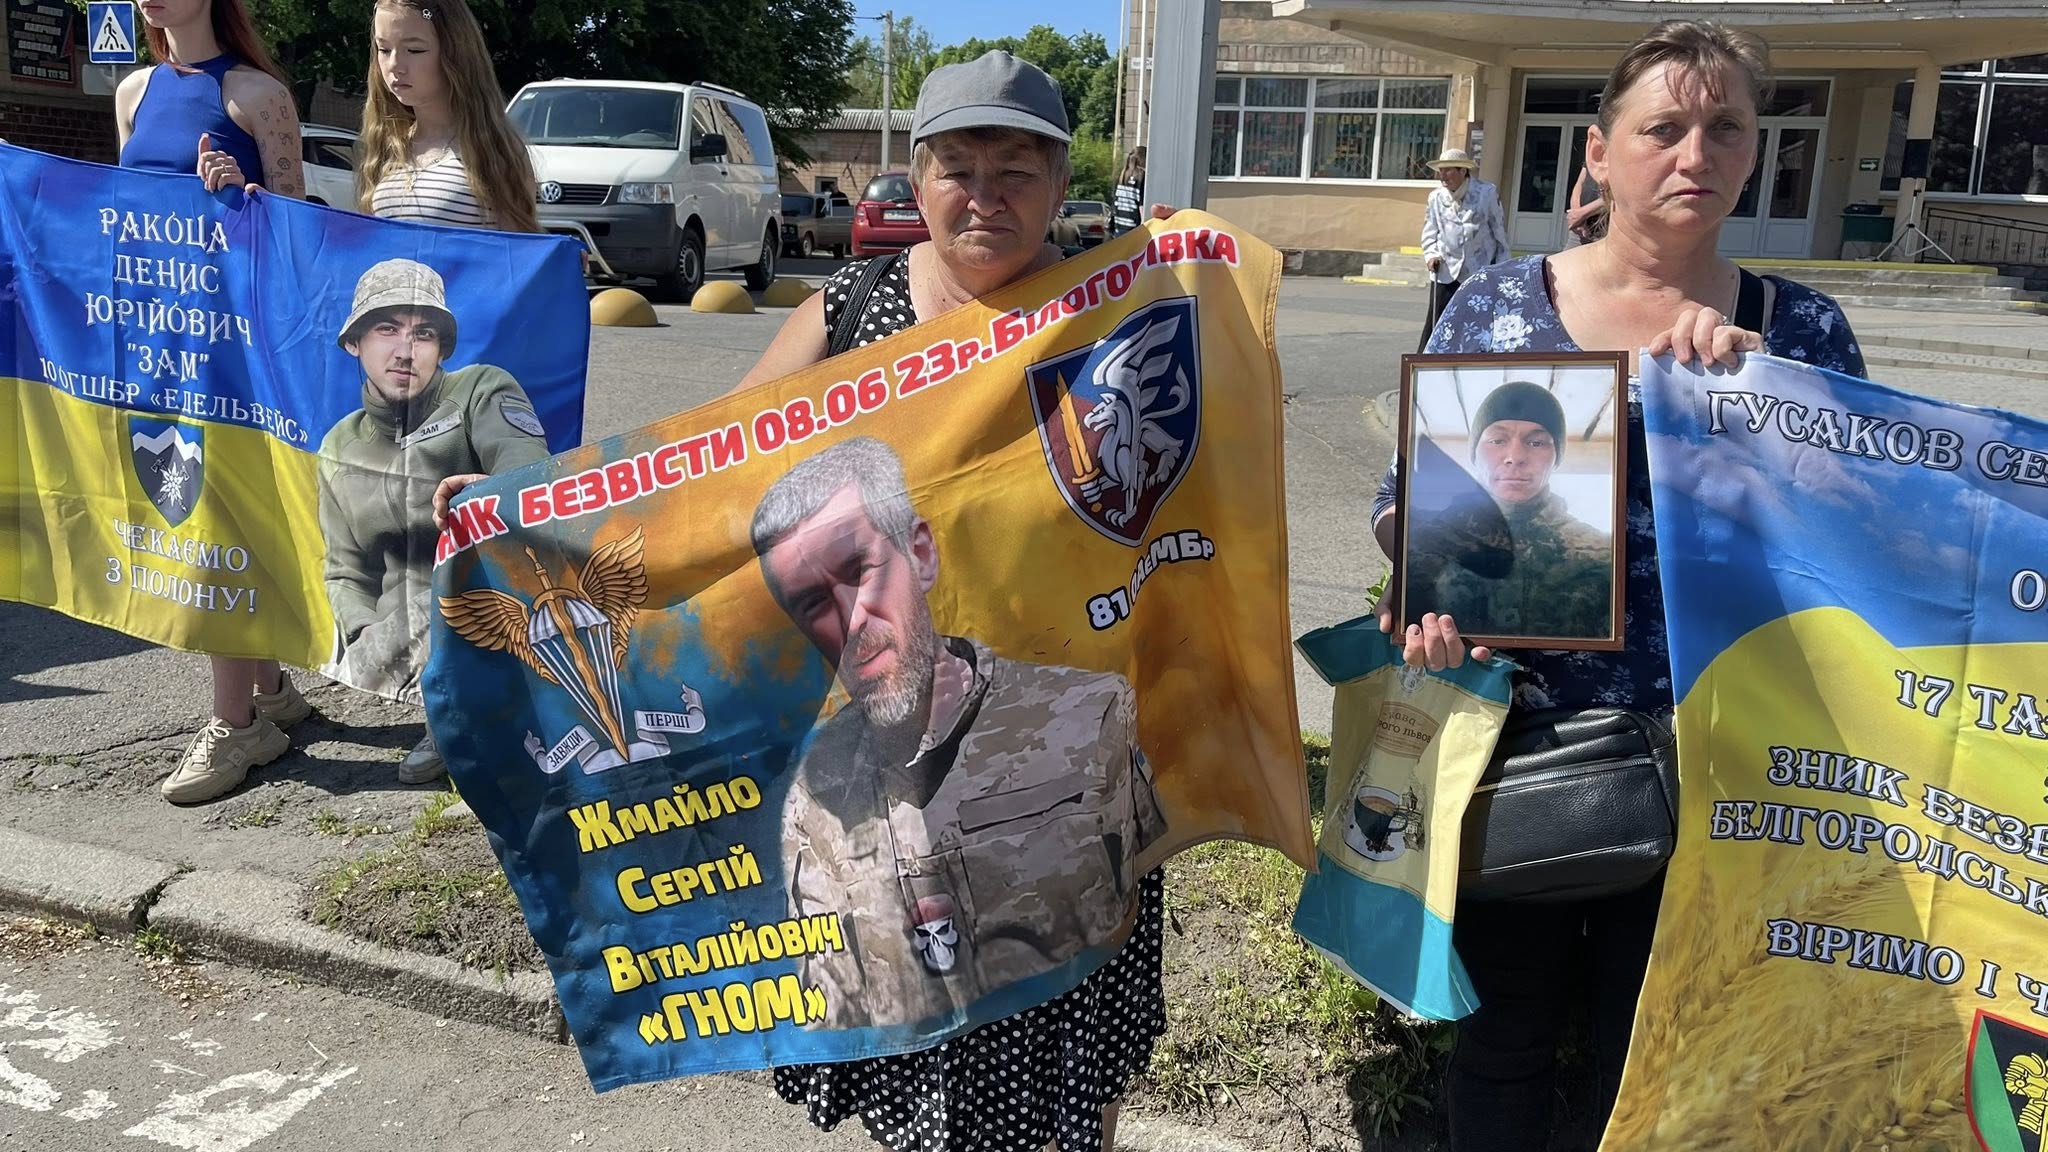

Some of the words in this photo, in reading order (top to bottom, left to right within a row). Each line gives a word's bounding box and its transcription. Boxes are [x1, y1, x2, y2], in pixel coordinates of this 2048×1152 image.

[99, 207, 230, 254] РАКОЦА
[114, 254, 219, 295] ДЕНИС
[85, 292, 252, 346] ЮРІЙОВИЧ
[127, 342, 210, 383] "ЗАМ"
[150, 388, 309, 443] «ЕДЕЛЬВЕЙС»
[420, 424, 439, 437] ЗАМ
[1706, 390, 1964, 471] ГУСАКОВ
[518, 422, 747, 528] БЕЗВІСТИ
[752, 367, 889, 454] 08.06
[113, 518, 250, 573] ЧЕКАЄМО
[105, 556, 122, 584] З
[131, 564, 257, 614] ПОЛОНУ!
[1086, 585, 1130, 631] 81
[1895, 669, 1954, 718] 17
[645, 713, 690, 729] ПЕРШІ
[547, 730, 584, 768] ЗАВЖДИ
[1767, 746, 1909, 807] ЗНИК
[1766, 918, 1965, 986] ВІРИМО
[1975, 959, 2001, 998] І
[637, 974, 828, 1046] «ГНОМ»
